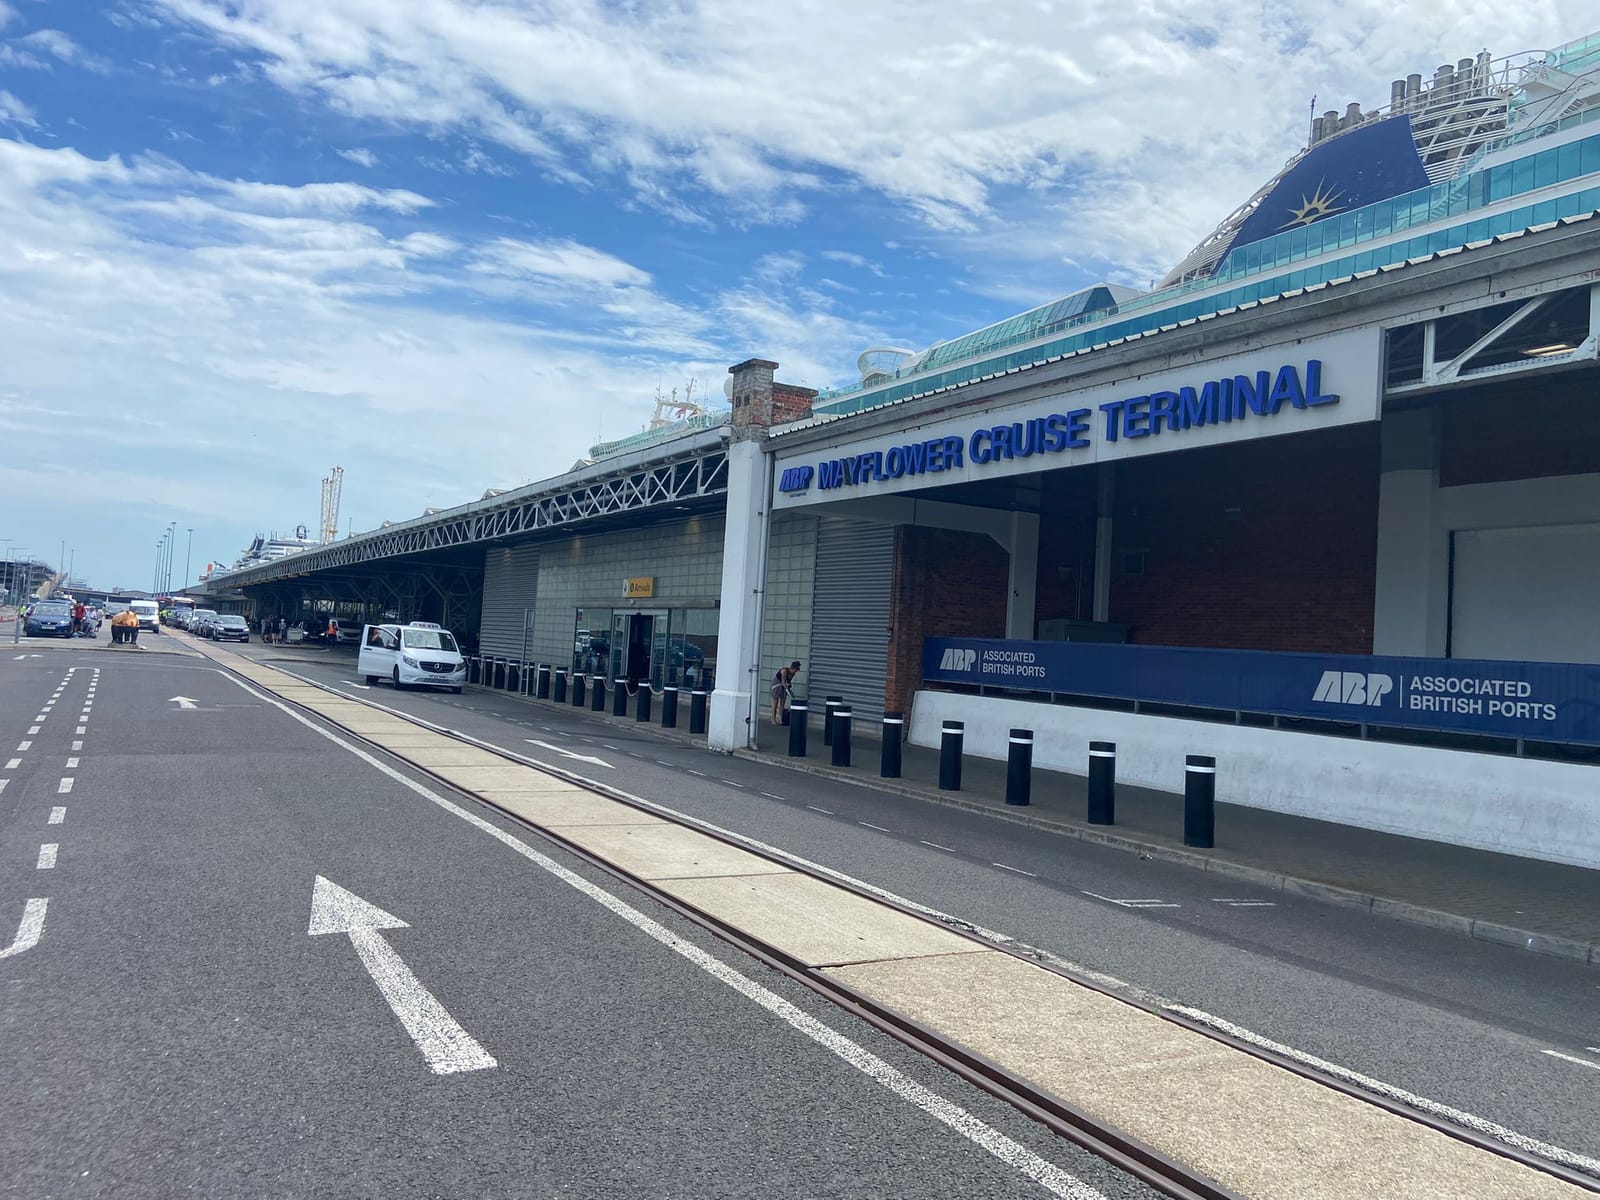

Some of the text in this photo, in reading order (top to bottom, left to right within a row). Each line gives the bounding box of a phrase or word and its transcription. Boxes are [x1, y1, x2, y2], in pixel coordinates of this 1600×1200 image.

[779, 359, 1340, 492] ABP MAYFLOWER CRUISE TERMINAL
[940, 648, 976, 671] ABP
[983, 650, 1035, 663] ASSOCIATED
[983, 663, 1046, 677] BRITISH PORTS
[1312, 671, 1393, 706] ABP
[1410, 676, 1531, 697] ASSOCIATED
[1410, 695, 1557, 720] BRITISH PORTS
